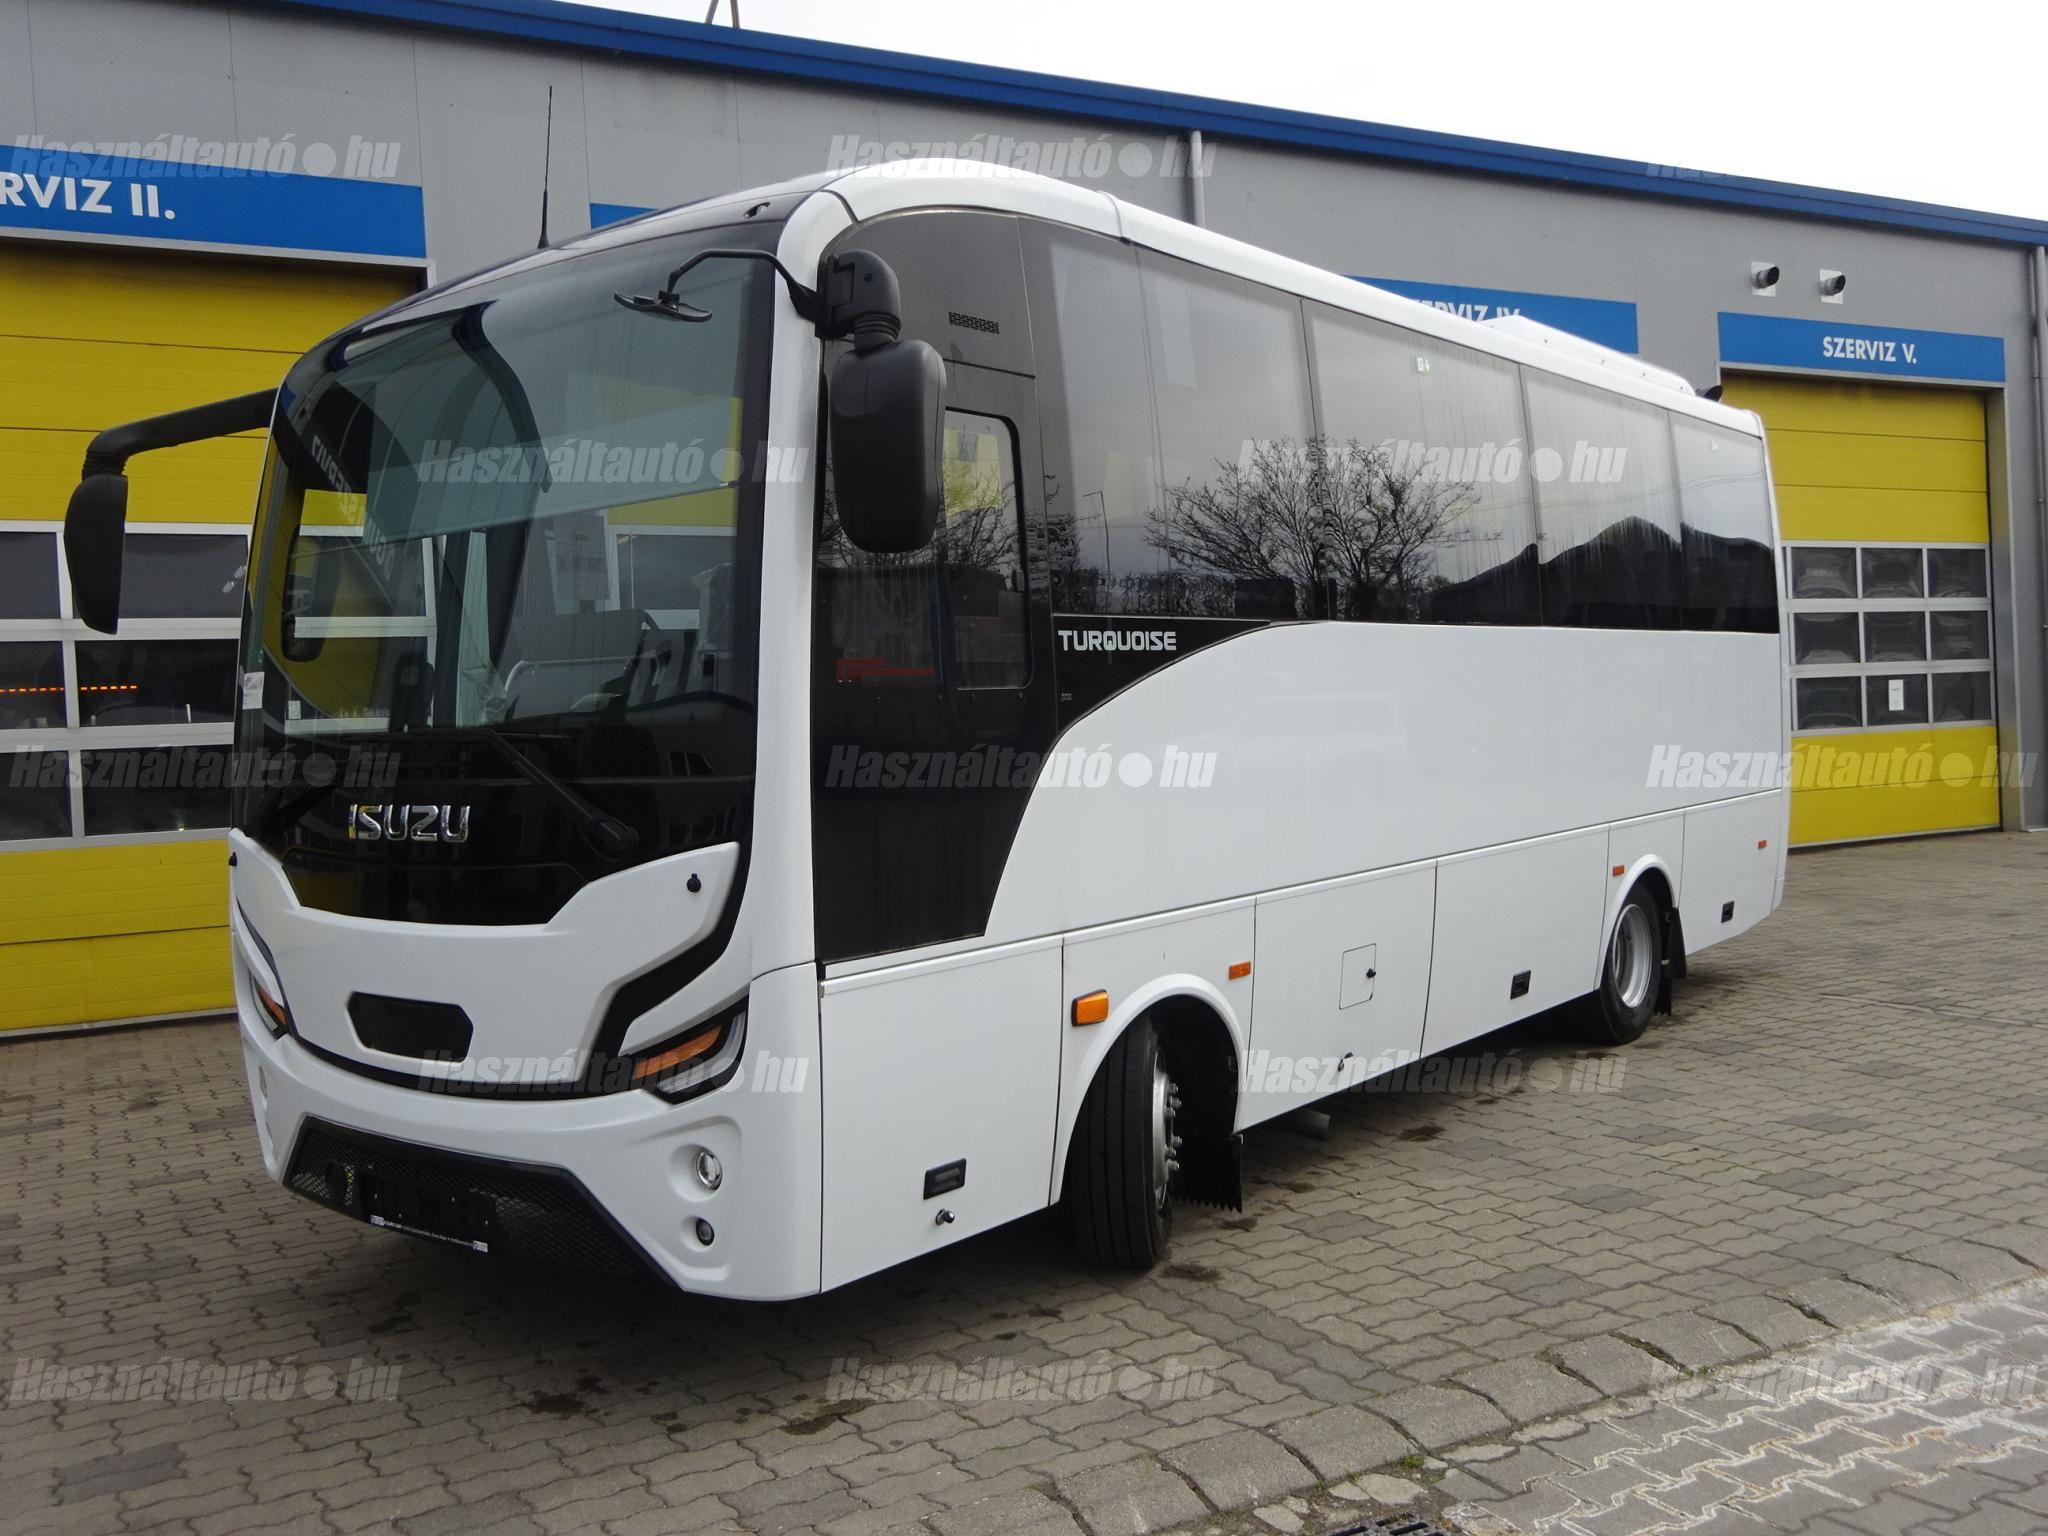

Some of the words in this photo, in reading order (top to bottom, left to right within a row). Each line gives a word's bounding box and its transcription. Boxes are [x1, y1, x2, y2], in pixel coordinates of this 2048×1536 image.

[130, 183, 175, 219] II.
[1822, 336, 1896, 362] SZERVIZ
[1901, 343, 1917, 364] V.
[1058, 630, 1177, 651] TURQUOISE
[348, 804, 471, 842] ISUZU
